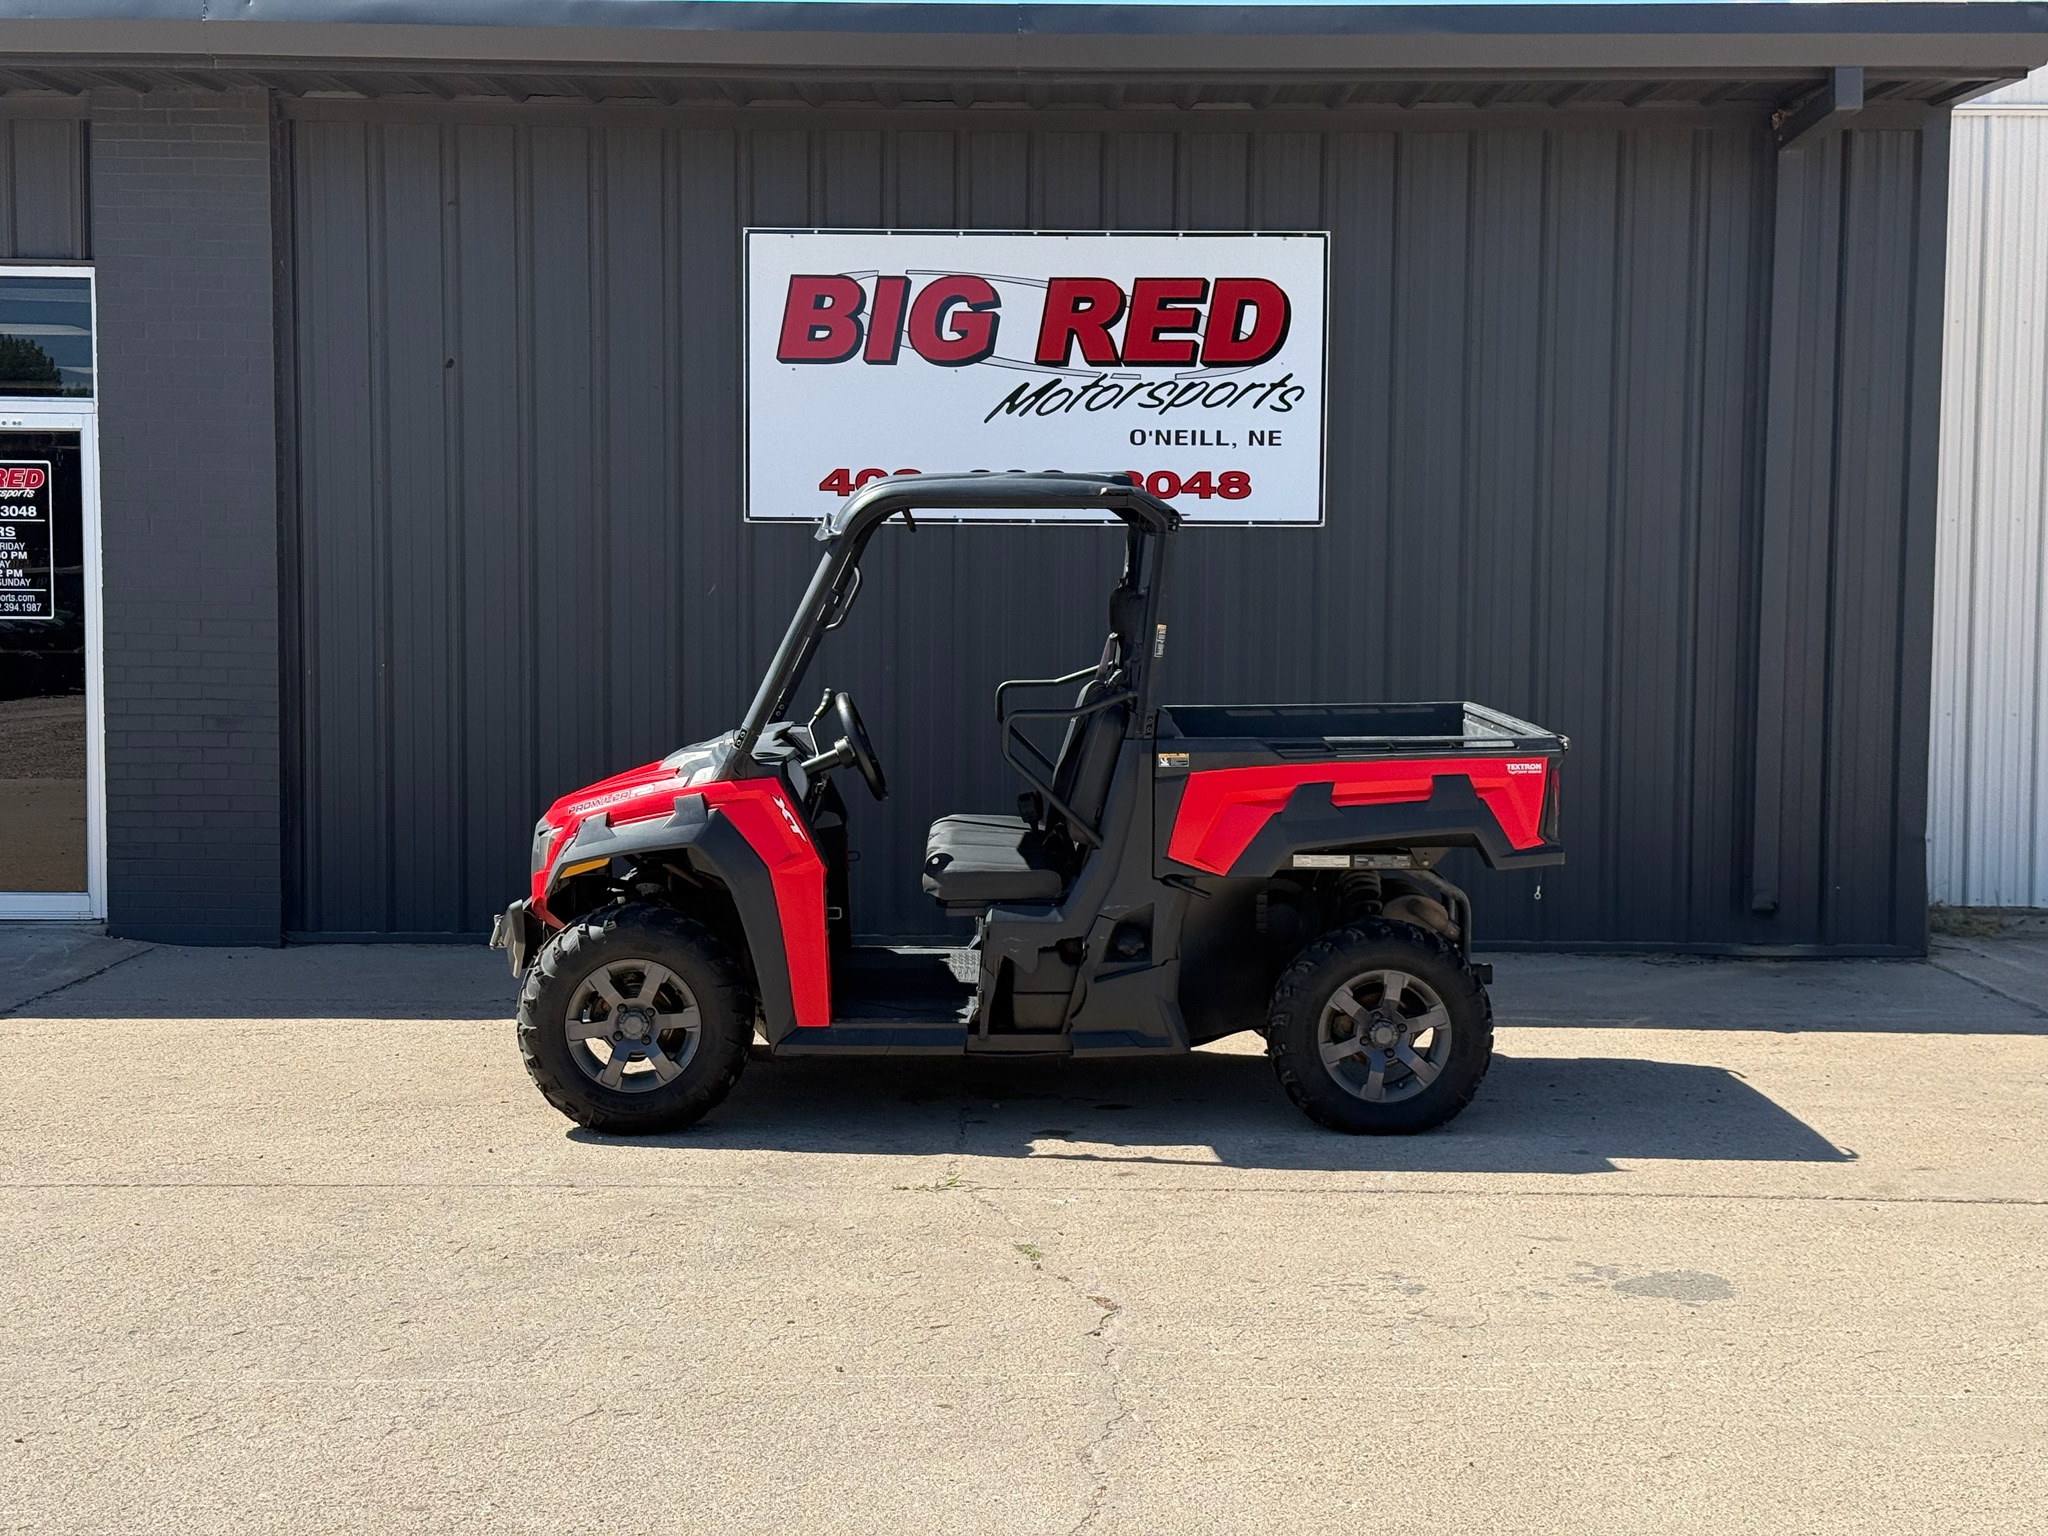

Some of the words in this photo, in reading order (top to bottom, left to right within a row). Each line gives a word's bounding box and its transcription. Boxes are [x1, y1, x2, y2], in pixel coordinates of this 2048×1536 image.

[776, 273, 1002, 366] BIG
[1034, 276, 1292, 368] RED
[983, 373, 1305, 423] Motorsports
[1129, 428, 1237, 449] O'NEILL,
[1248, 430, 1283, 447] NE
[818, 468, 922, 497] 40
[0, 488, 35, 500] sports
[11, 551, 28, 560] PM
[6, 569, 23, 577] PM
[568, 791, 629, 814] PROWLER
